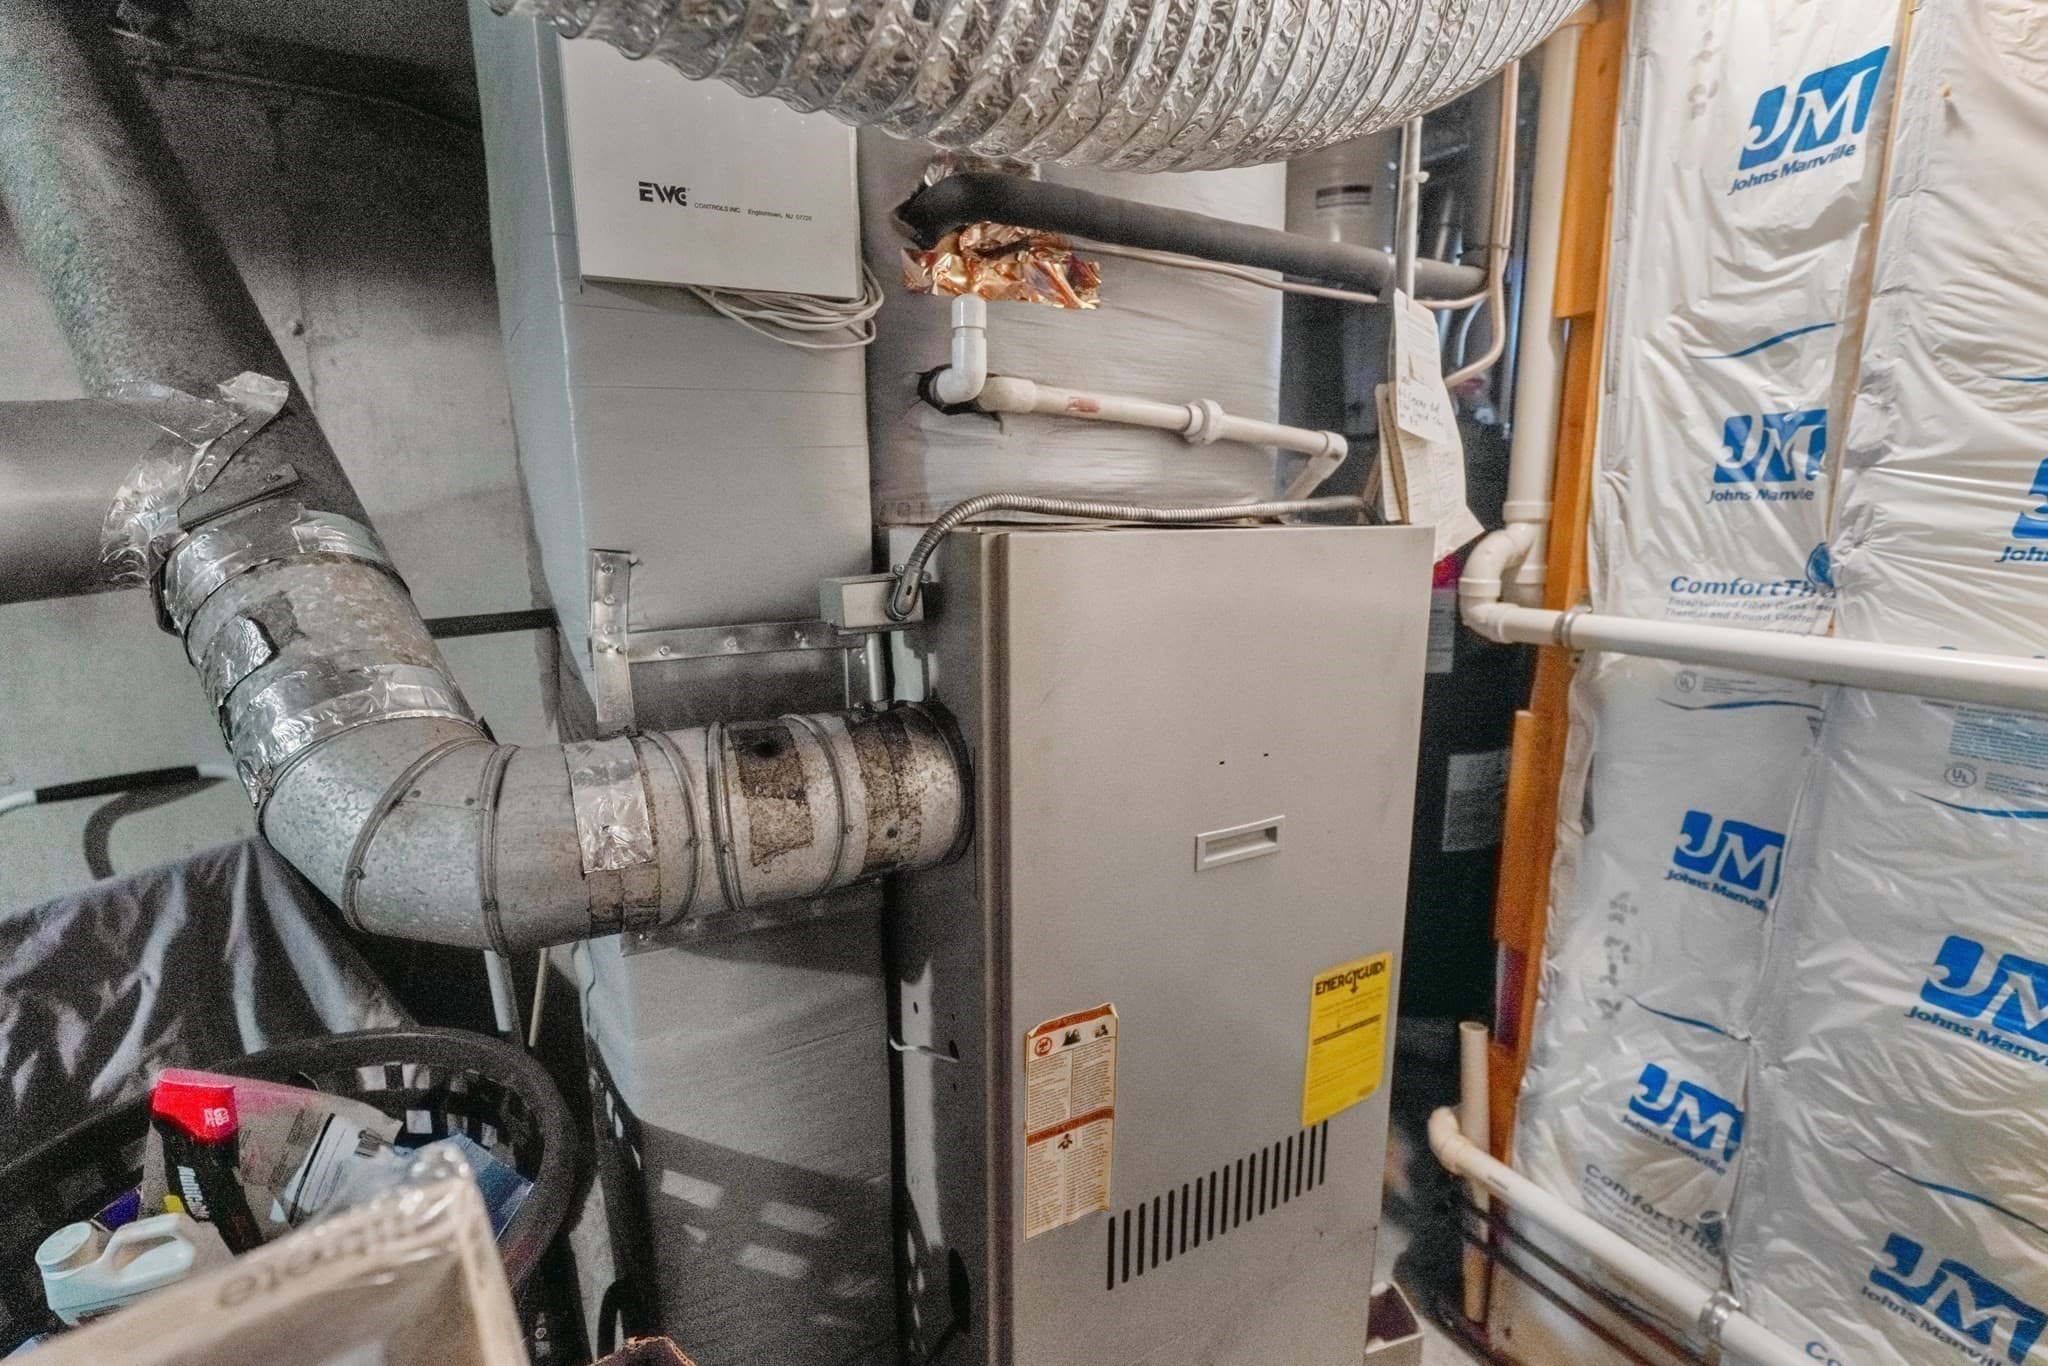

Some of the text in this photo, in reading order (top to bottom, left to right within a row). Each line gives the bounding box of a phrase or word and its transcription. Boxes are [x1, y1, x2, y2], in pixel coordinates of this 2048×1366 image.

[1739, 45, 1890, 171] JM
[1727, 143, 1857, 196] Johns Manville
[638, 181, 688, 207] EWC
[694, 202, 729, 213] CONTROLS
[1714, 409, 1828, 483] JM
[1705, 489, 1753, 504] Johns
[1994, 545, 2048, 563] Joh
[1674, 810, 1786, 899] JM
[1664, 869, 1710, 891] Johns
[1903, 1005, 1975, 1038] Johns
[1629, 1062, 1744, 1162] JM
[1861, 1285, 1918, 1323] Johns
[1869, 1232, 2048, 1365] JM
